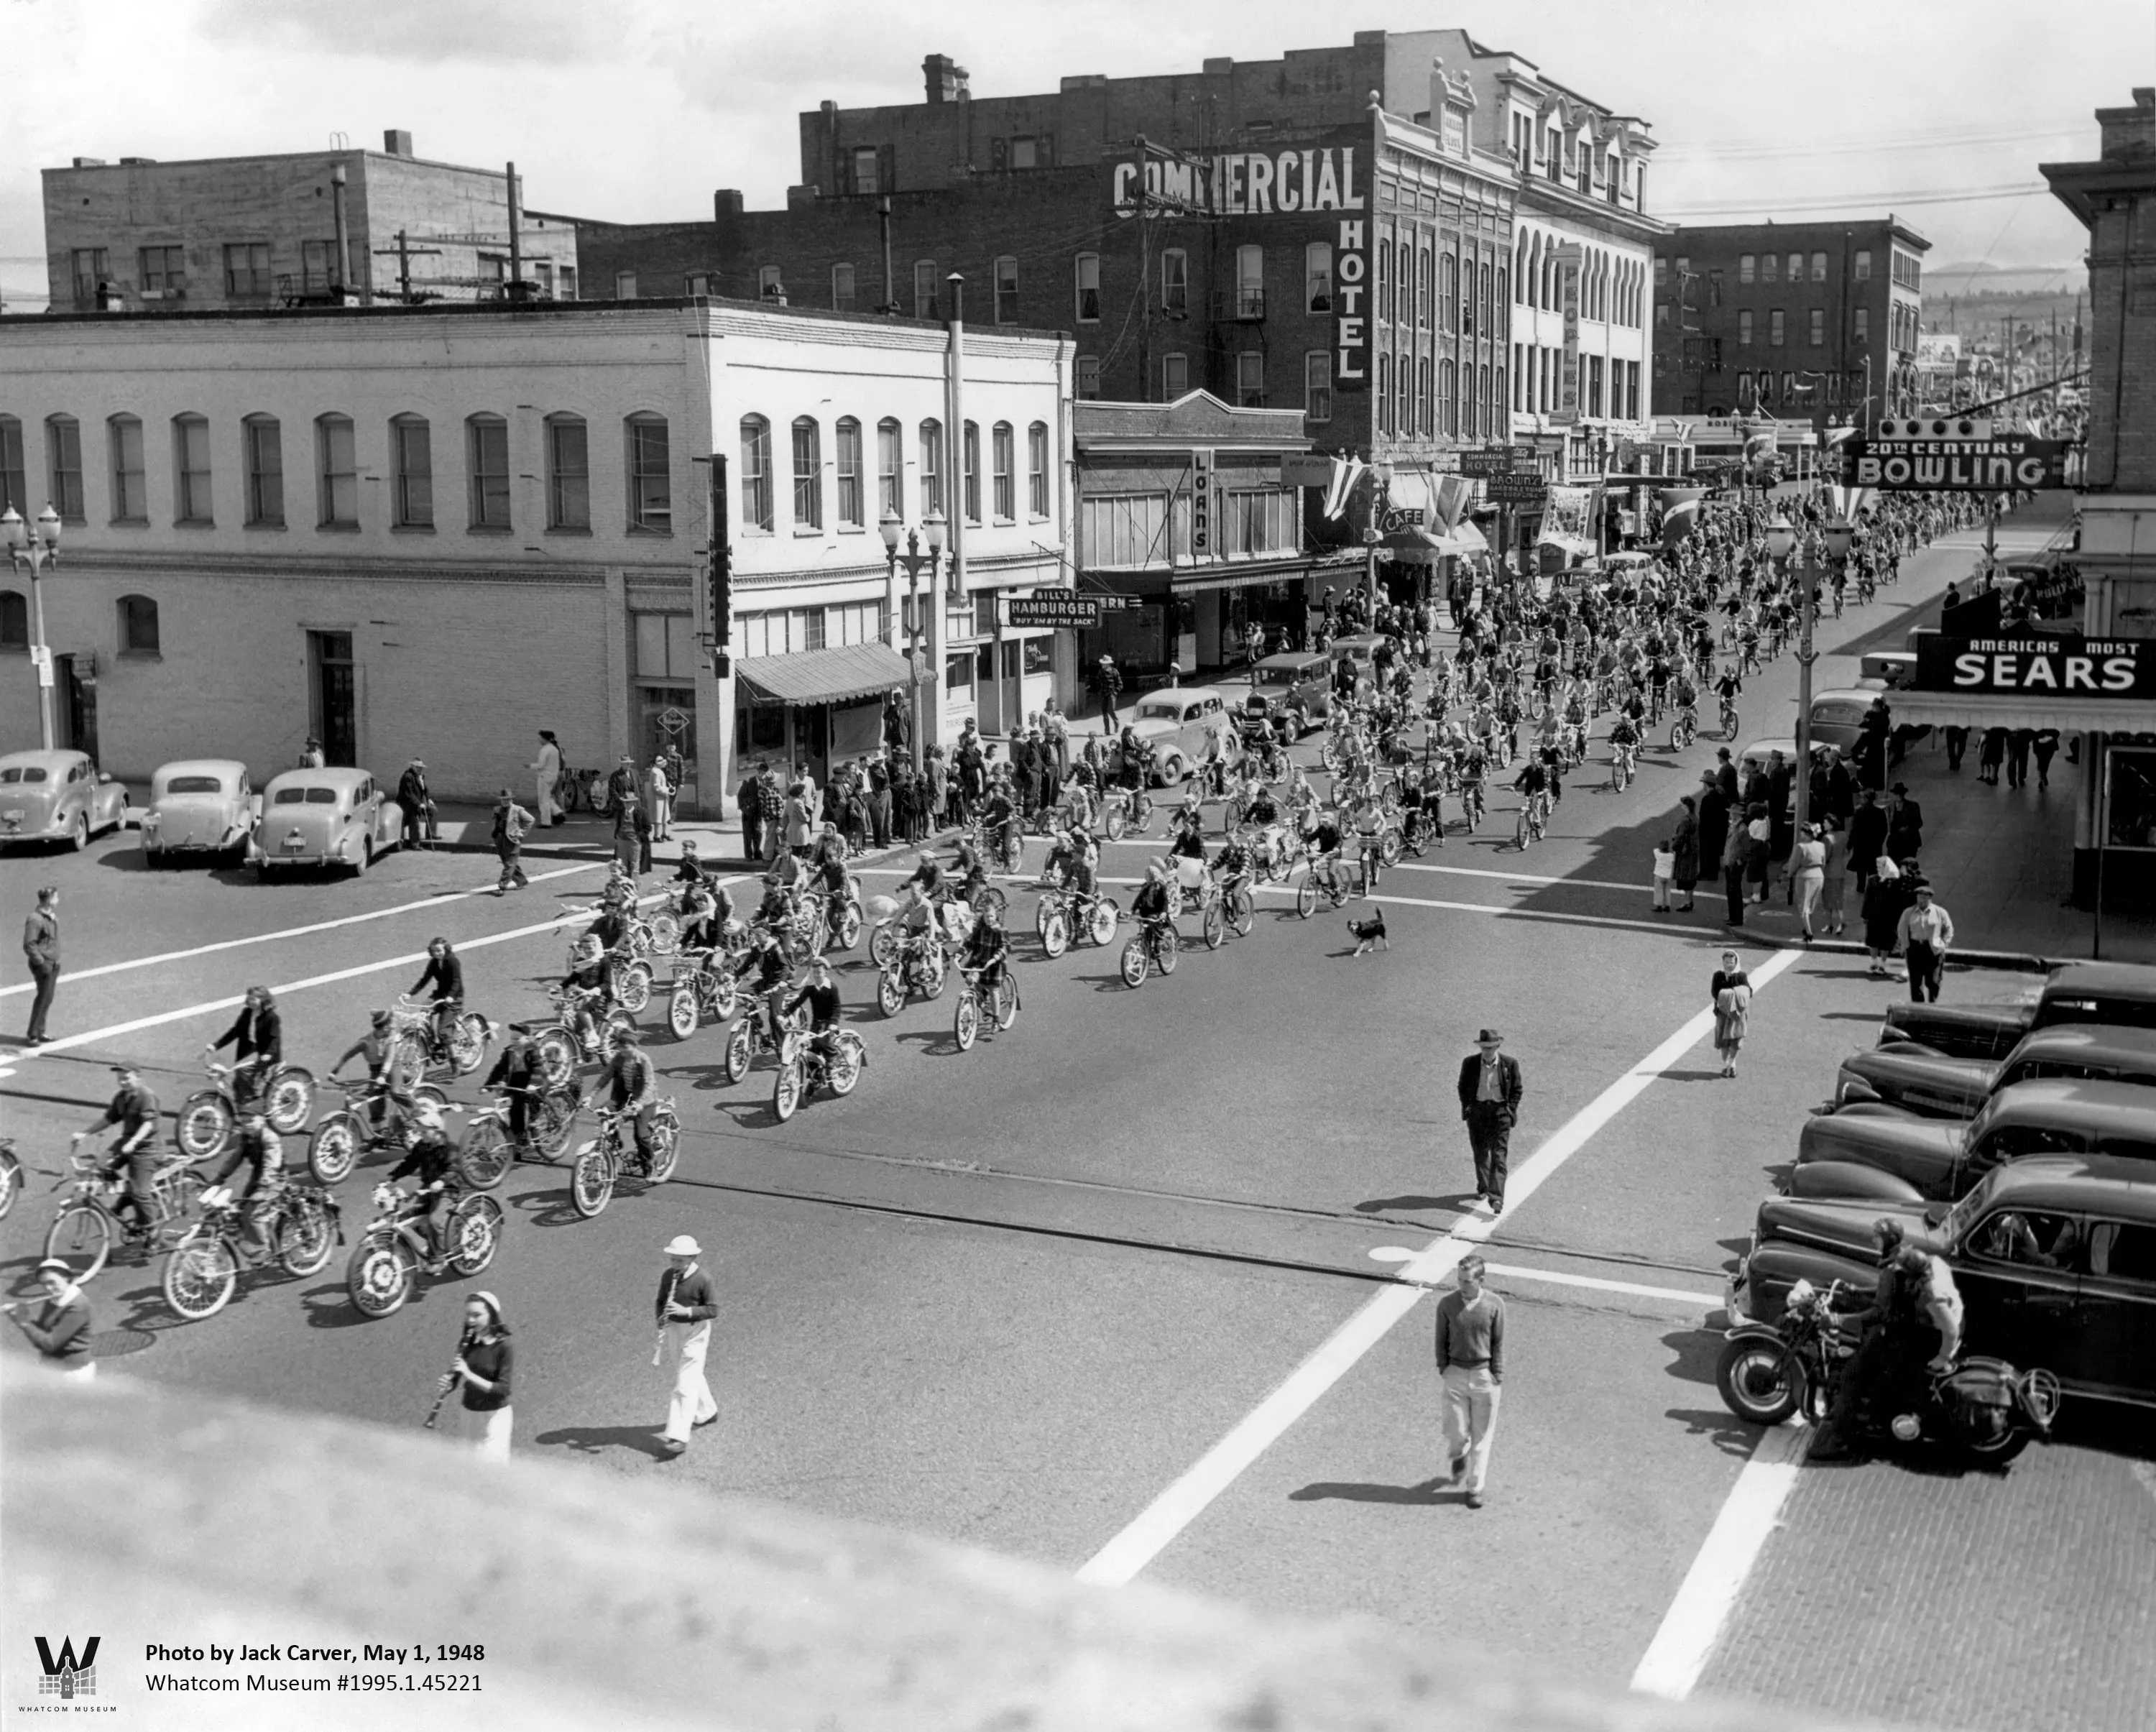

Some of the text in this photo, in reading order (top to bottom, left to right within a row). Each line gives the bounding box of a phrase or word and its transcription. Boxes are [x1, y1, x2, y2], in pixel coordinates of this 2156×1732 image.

[1114, 147, 1364, 218] COMMERCIAL
[1339, 219, 1365, 379] HOTEL
[1563, 265, 1577, 405] PEOPLES
[1866, 442, 2024, 454] 20TH CENTURY
[1466, 461, 1506, 470] HOTEL
[1858, 457, 2046, 484] BOWLING
[1490, 475, 1540, 485] BROWN'S
[1195, 454, 1207, 547] LOANS
[1386, 510, 1422, 530] CAFE
[1036, 590, 1070, 600] BILL'S
[1011, 602, 1097, 615] HAMBURGER
[1970, 640, 2140, 655] AMERICAS MOST
[1953, 653, 2137, 691] SEARS
